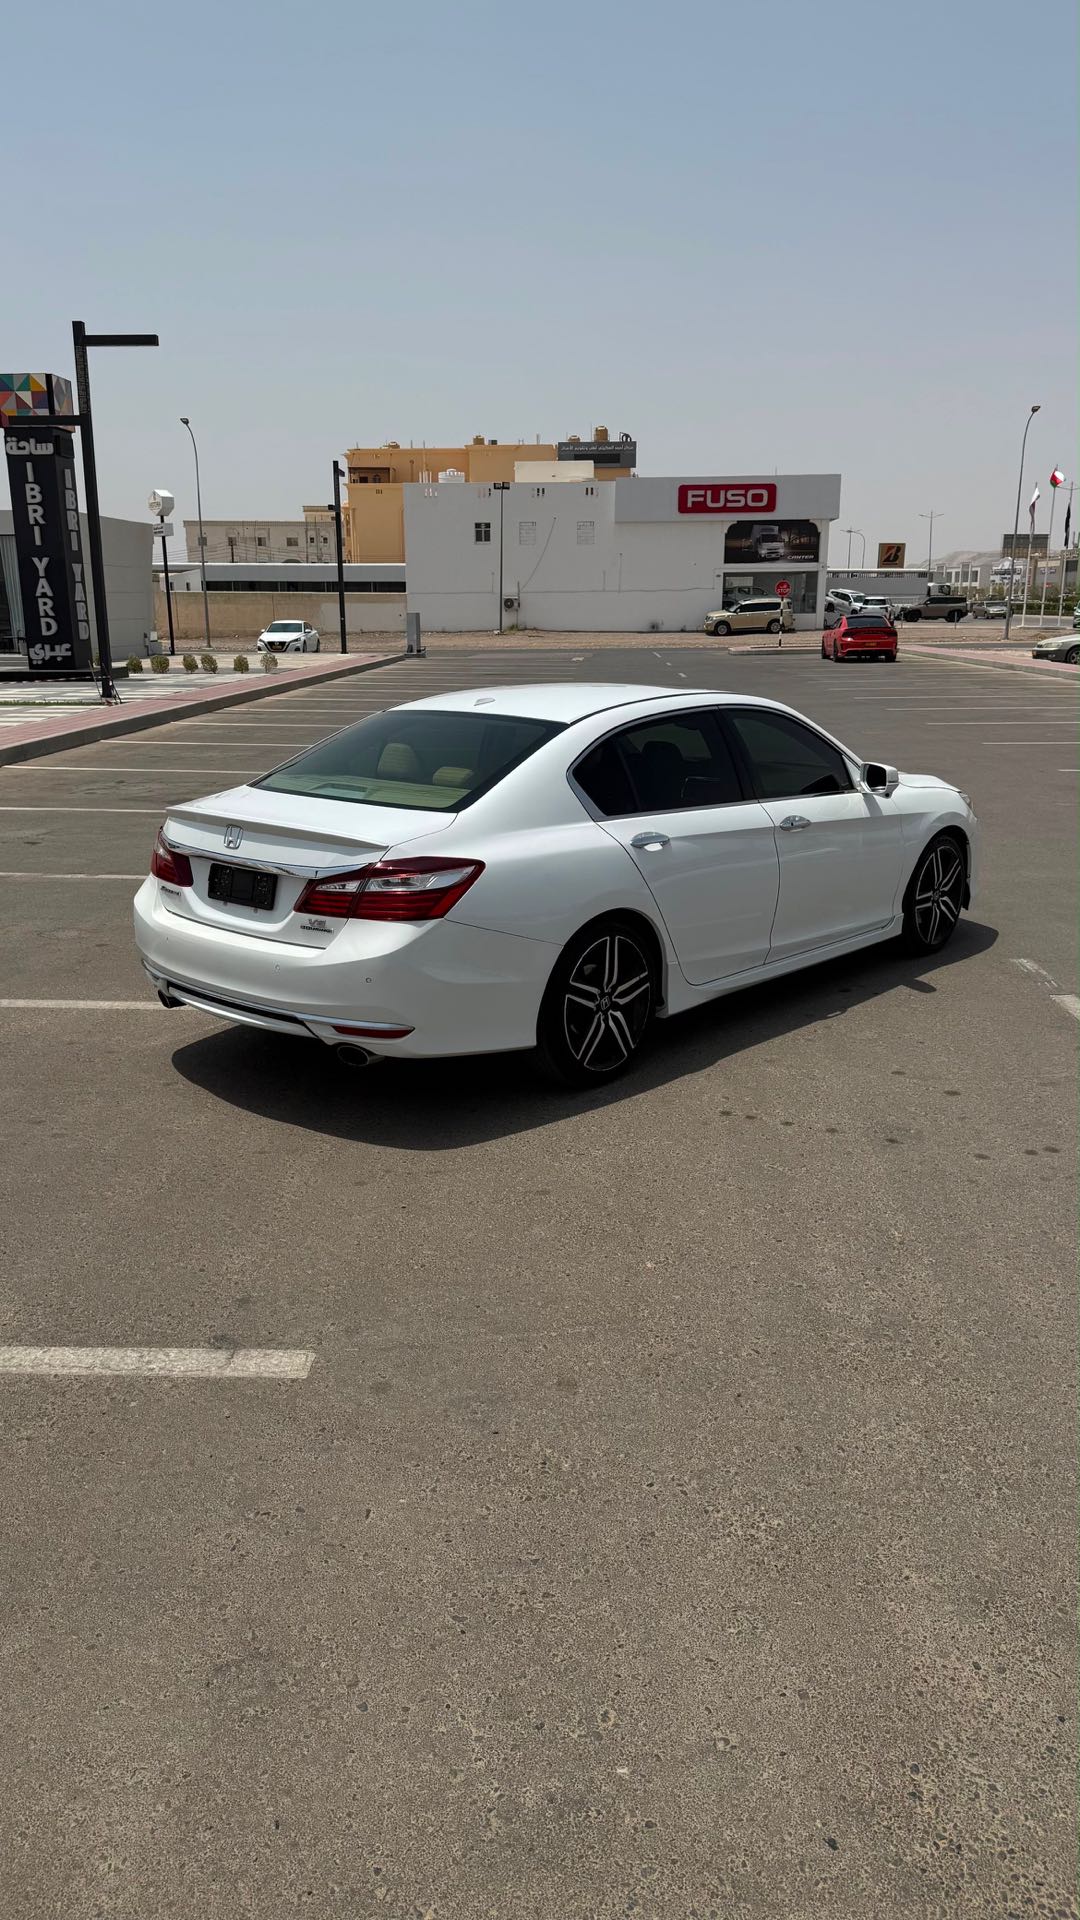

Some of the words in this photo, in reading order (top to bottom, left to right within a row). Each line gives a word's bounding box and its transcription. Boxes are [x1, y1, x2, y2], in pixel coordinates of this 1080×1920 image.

[5, 436, 54, 456] ساحة
[25, 461, 46, 546] IBRI
[64, 468, 80, 552] IBRI
[687, 489, 769, 508] FUSO
[31, 557, 58, 636] YARD
[71, 563, 90, 640] YARD
[28, 643, 72, 665] عبري
